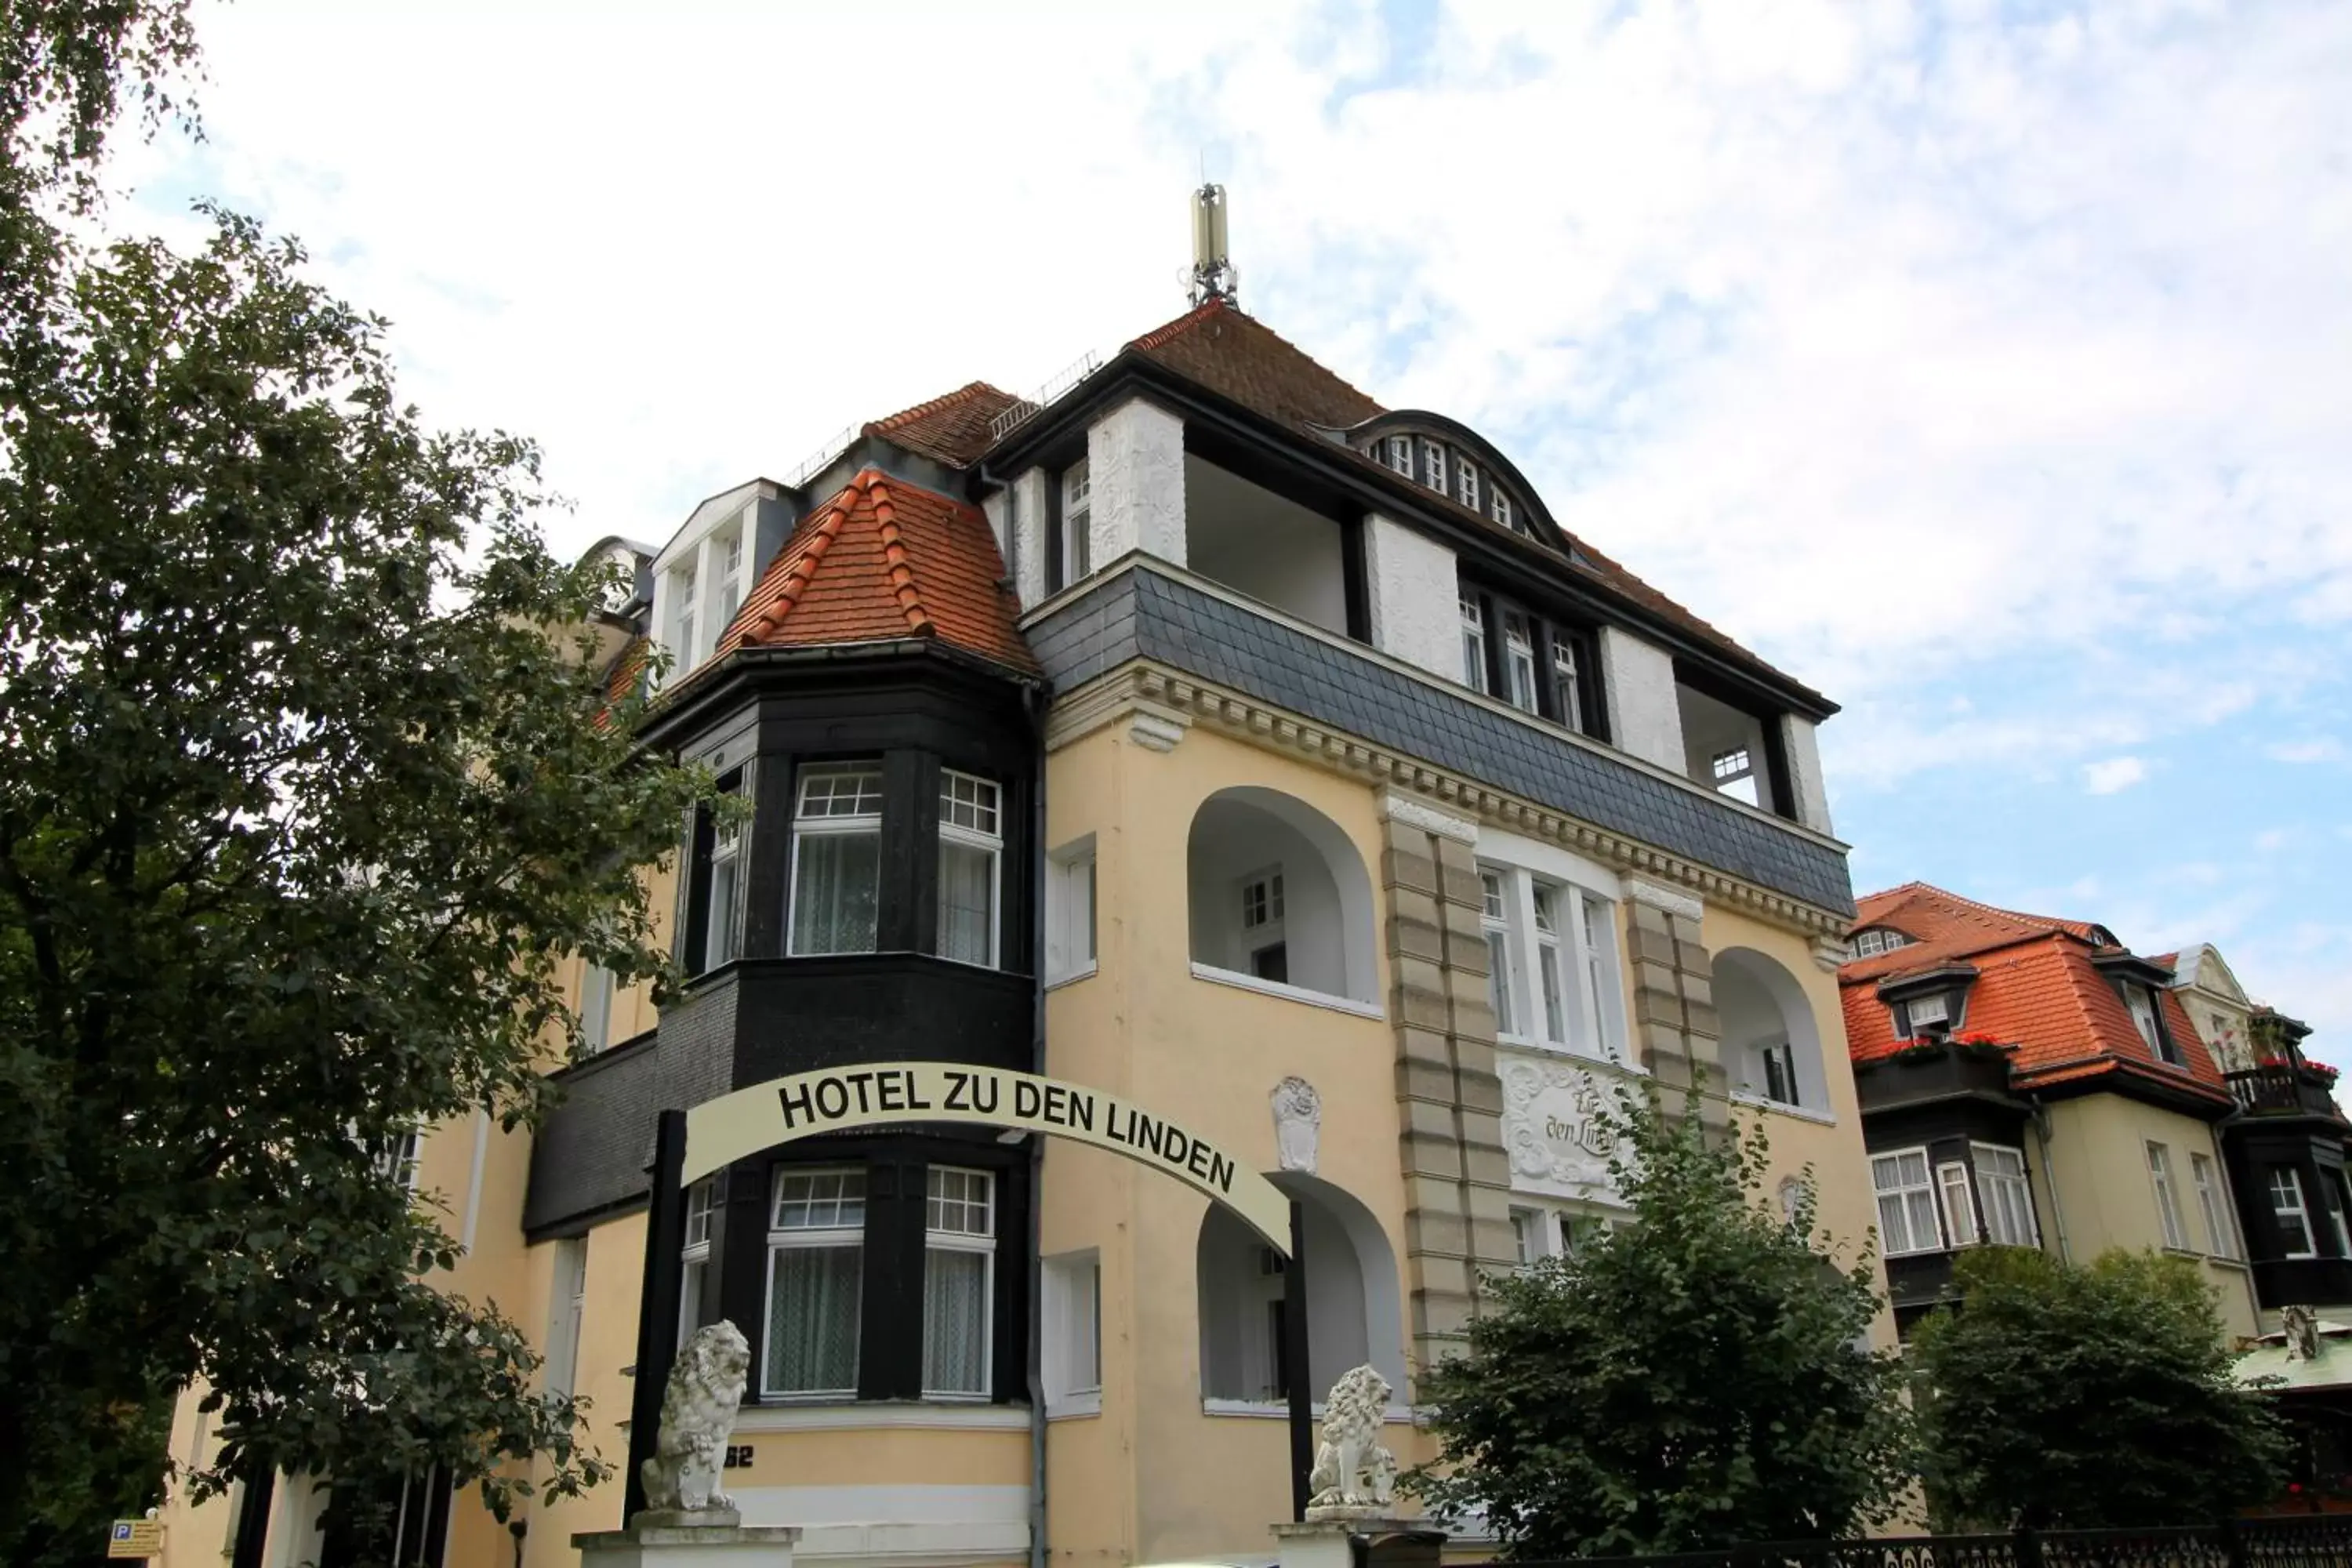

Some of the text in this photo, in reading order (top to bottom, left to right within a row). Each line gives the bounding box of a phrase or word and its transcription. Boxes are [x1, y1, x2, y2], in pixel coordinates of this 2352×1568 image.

[778, 1070, 1235, 1193] HOTEL ZU DEN LINDEN
[1546, 1113, 1574, 1143] den
[118, 1525, 128, 1537] P
